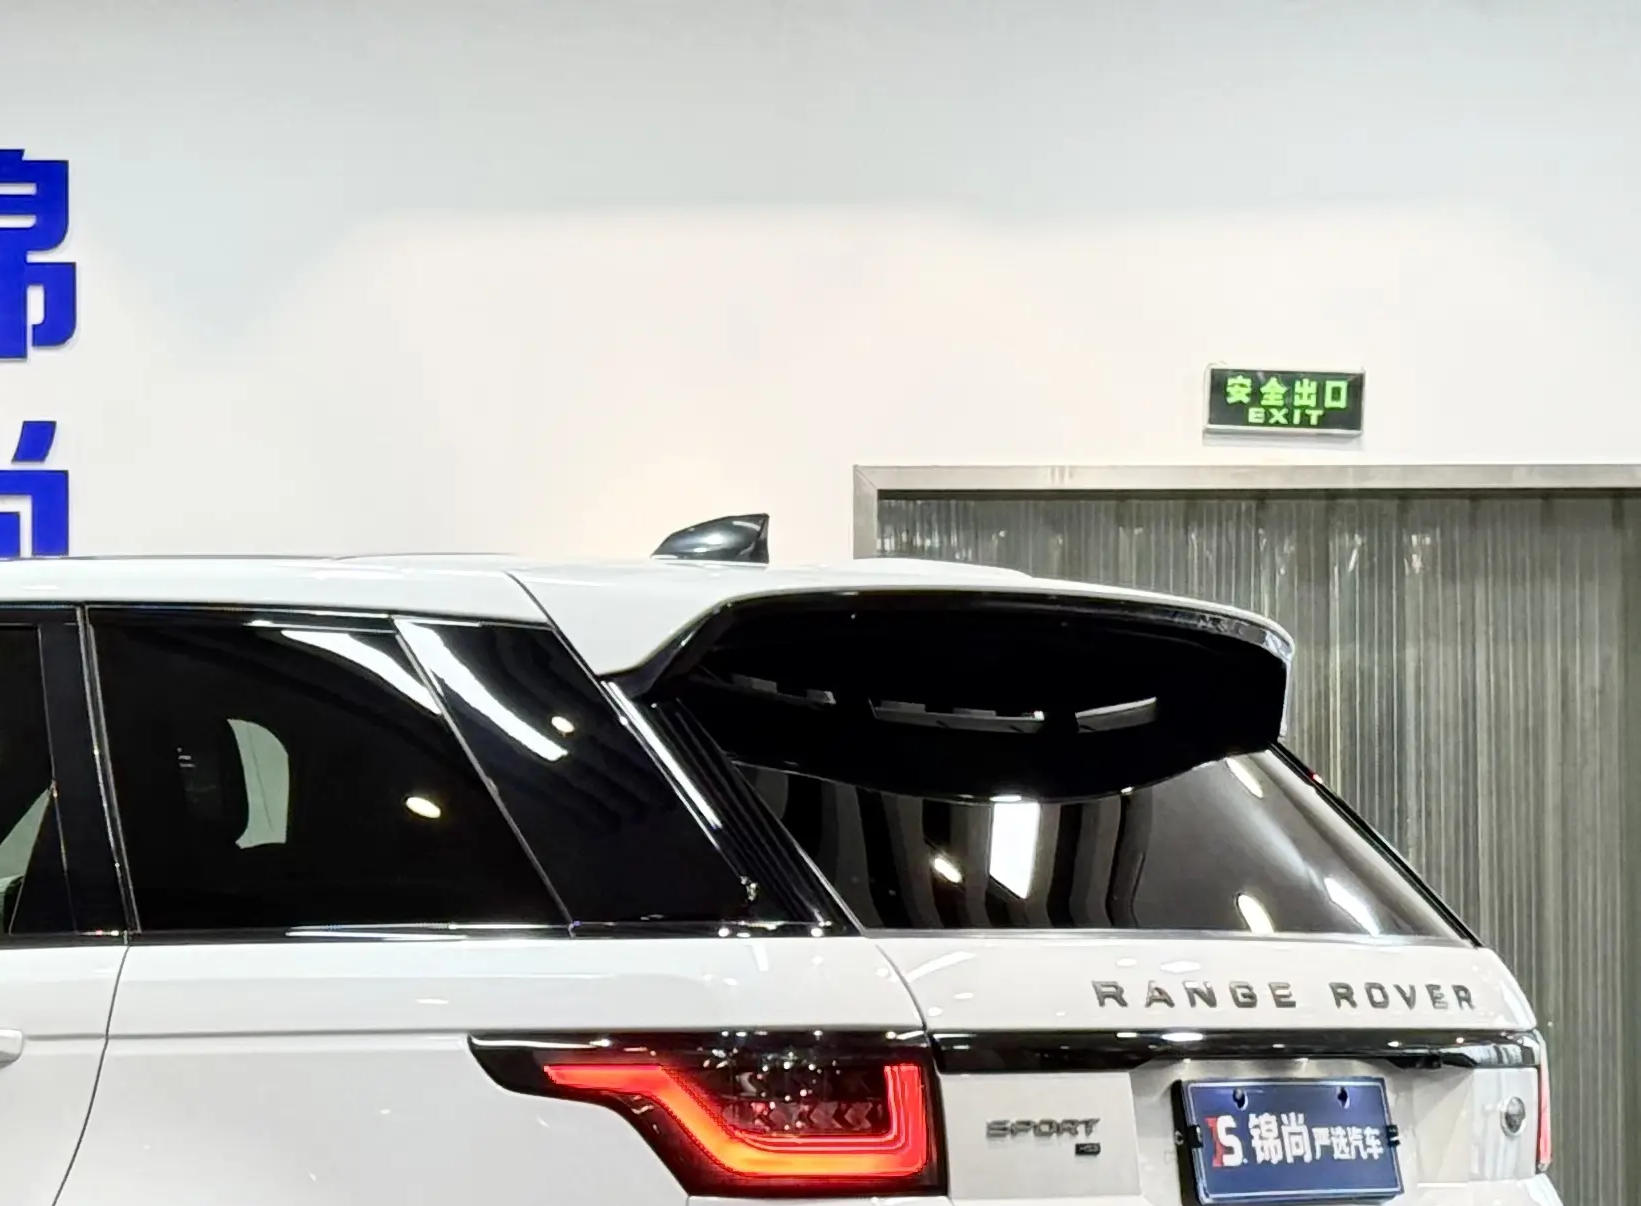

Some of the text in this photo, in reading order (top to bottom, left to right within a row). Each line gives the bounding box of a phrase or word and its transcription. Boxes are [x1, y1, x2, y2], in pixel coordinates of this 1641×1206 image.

[1226, 375, 1348, 409] 安全出口
[1247, 407, 1324, 425] EXIT
[1091, 980, 1477, 1011] RANGE ROVER
[985, 1118, 1101, 1139] SPORT
